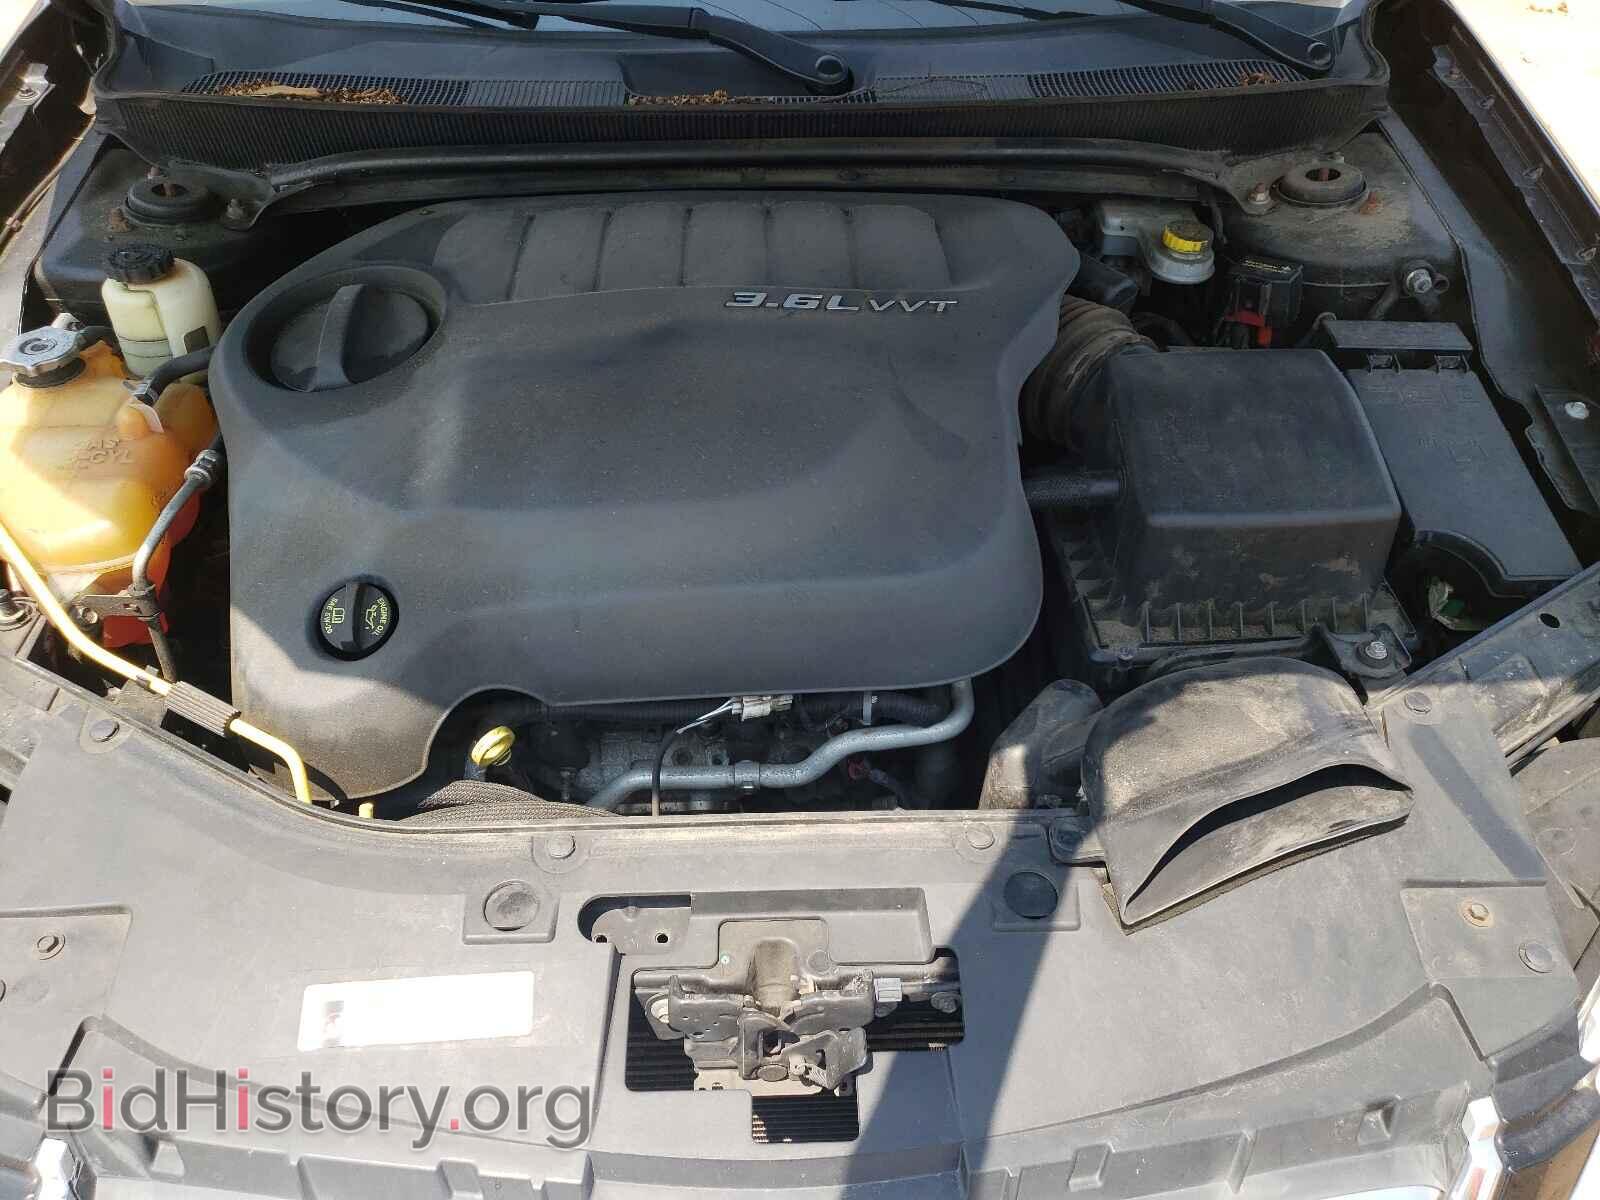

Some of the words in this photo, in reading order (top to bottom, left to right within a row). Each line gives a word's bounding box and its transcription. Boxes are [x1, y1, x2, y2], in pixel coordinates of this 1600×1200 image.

[725, 291, 860, 310] 3.6L
[869, 299, 958, 312] VVT
[376, 597, 388, 625] ENGINE
